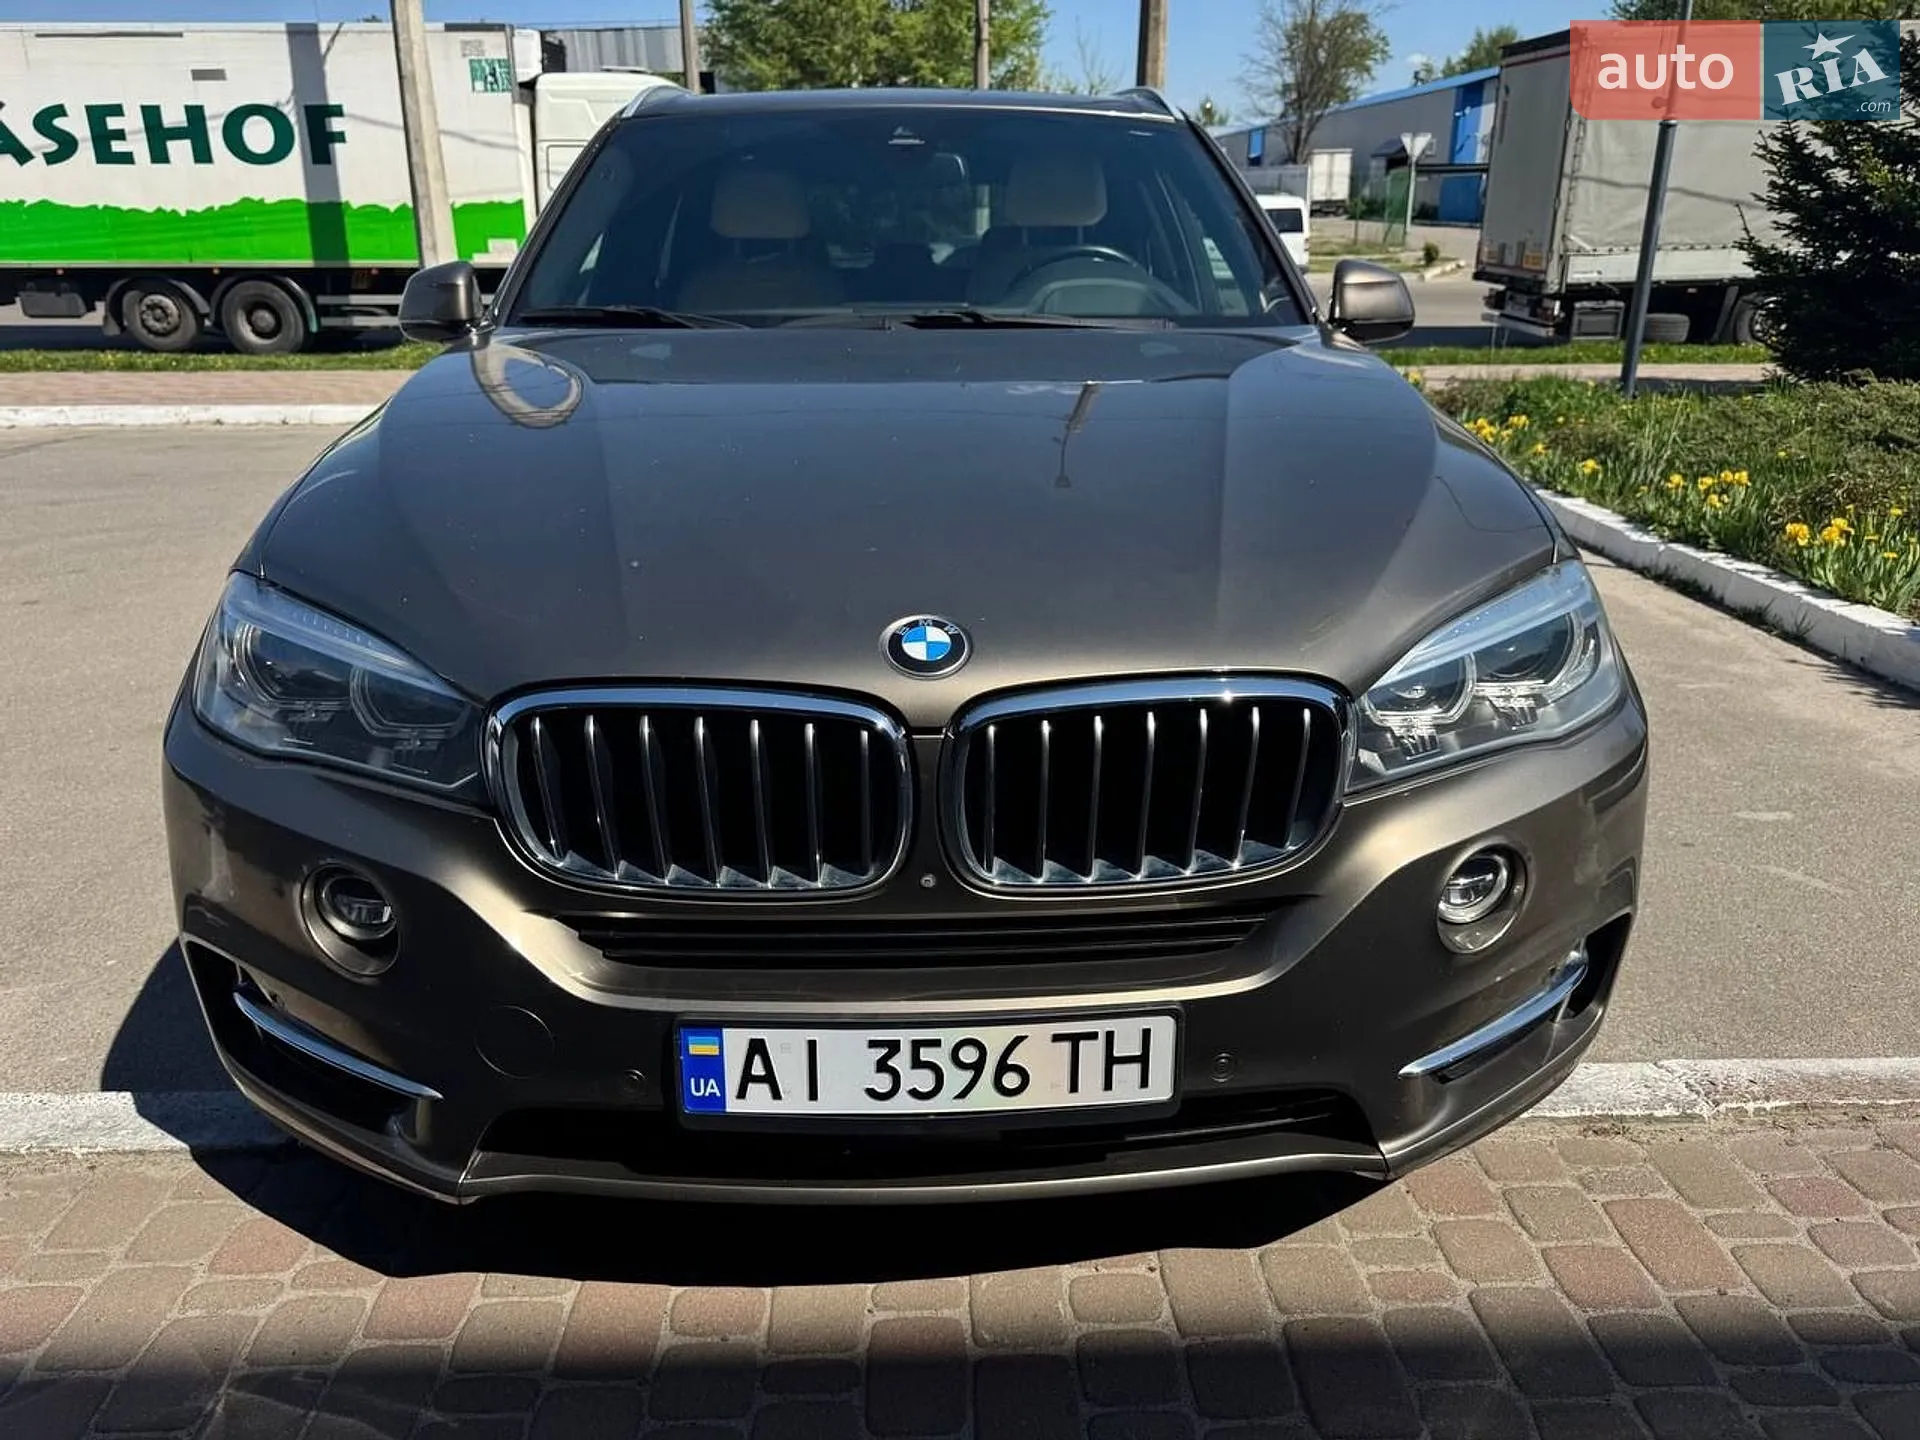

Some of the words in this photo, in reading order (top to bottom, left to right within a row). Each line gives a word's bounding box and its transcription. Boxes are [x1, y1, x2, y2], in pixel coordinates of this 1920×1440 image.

[895, 618, 959, 636] BMW
[735, 1037, 819, 1102] AI
[864, 1035, 1030, 1102] 3596
[1051, 1028, 1152, 1095] TH
[690, 1077, 721, 1097] UA
